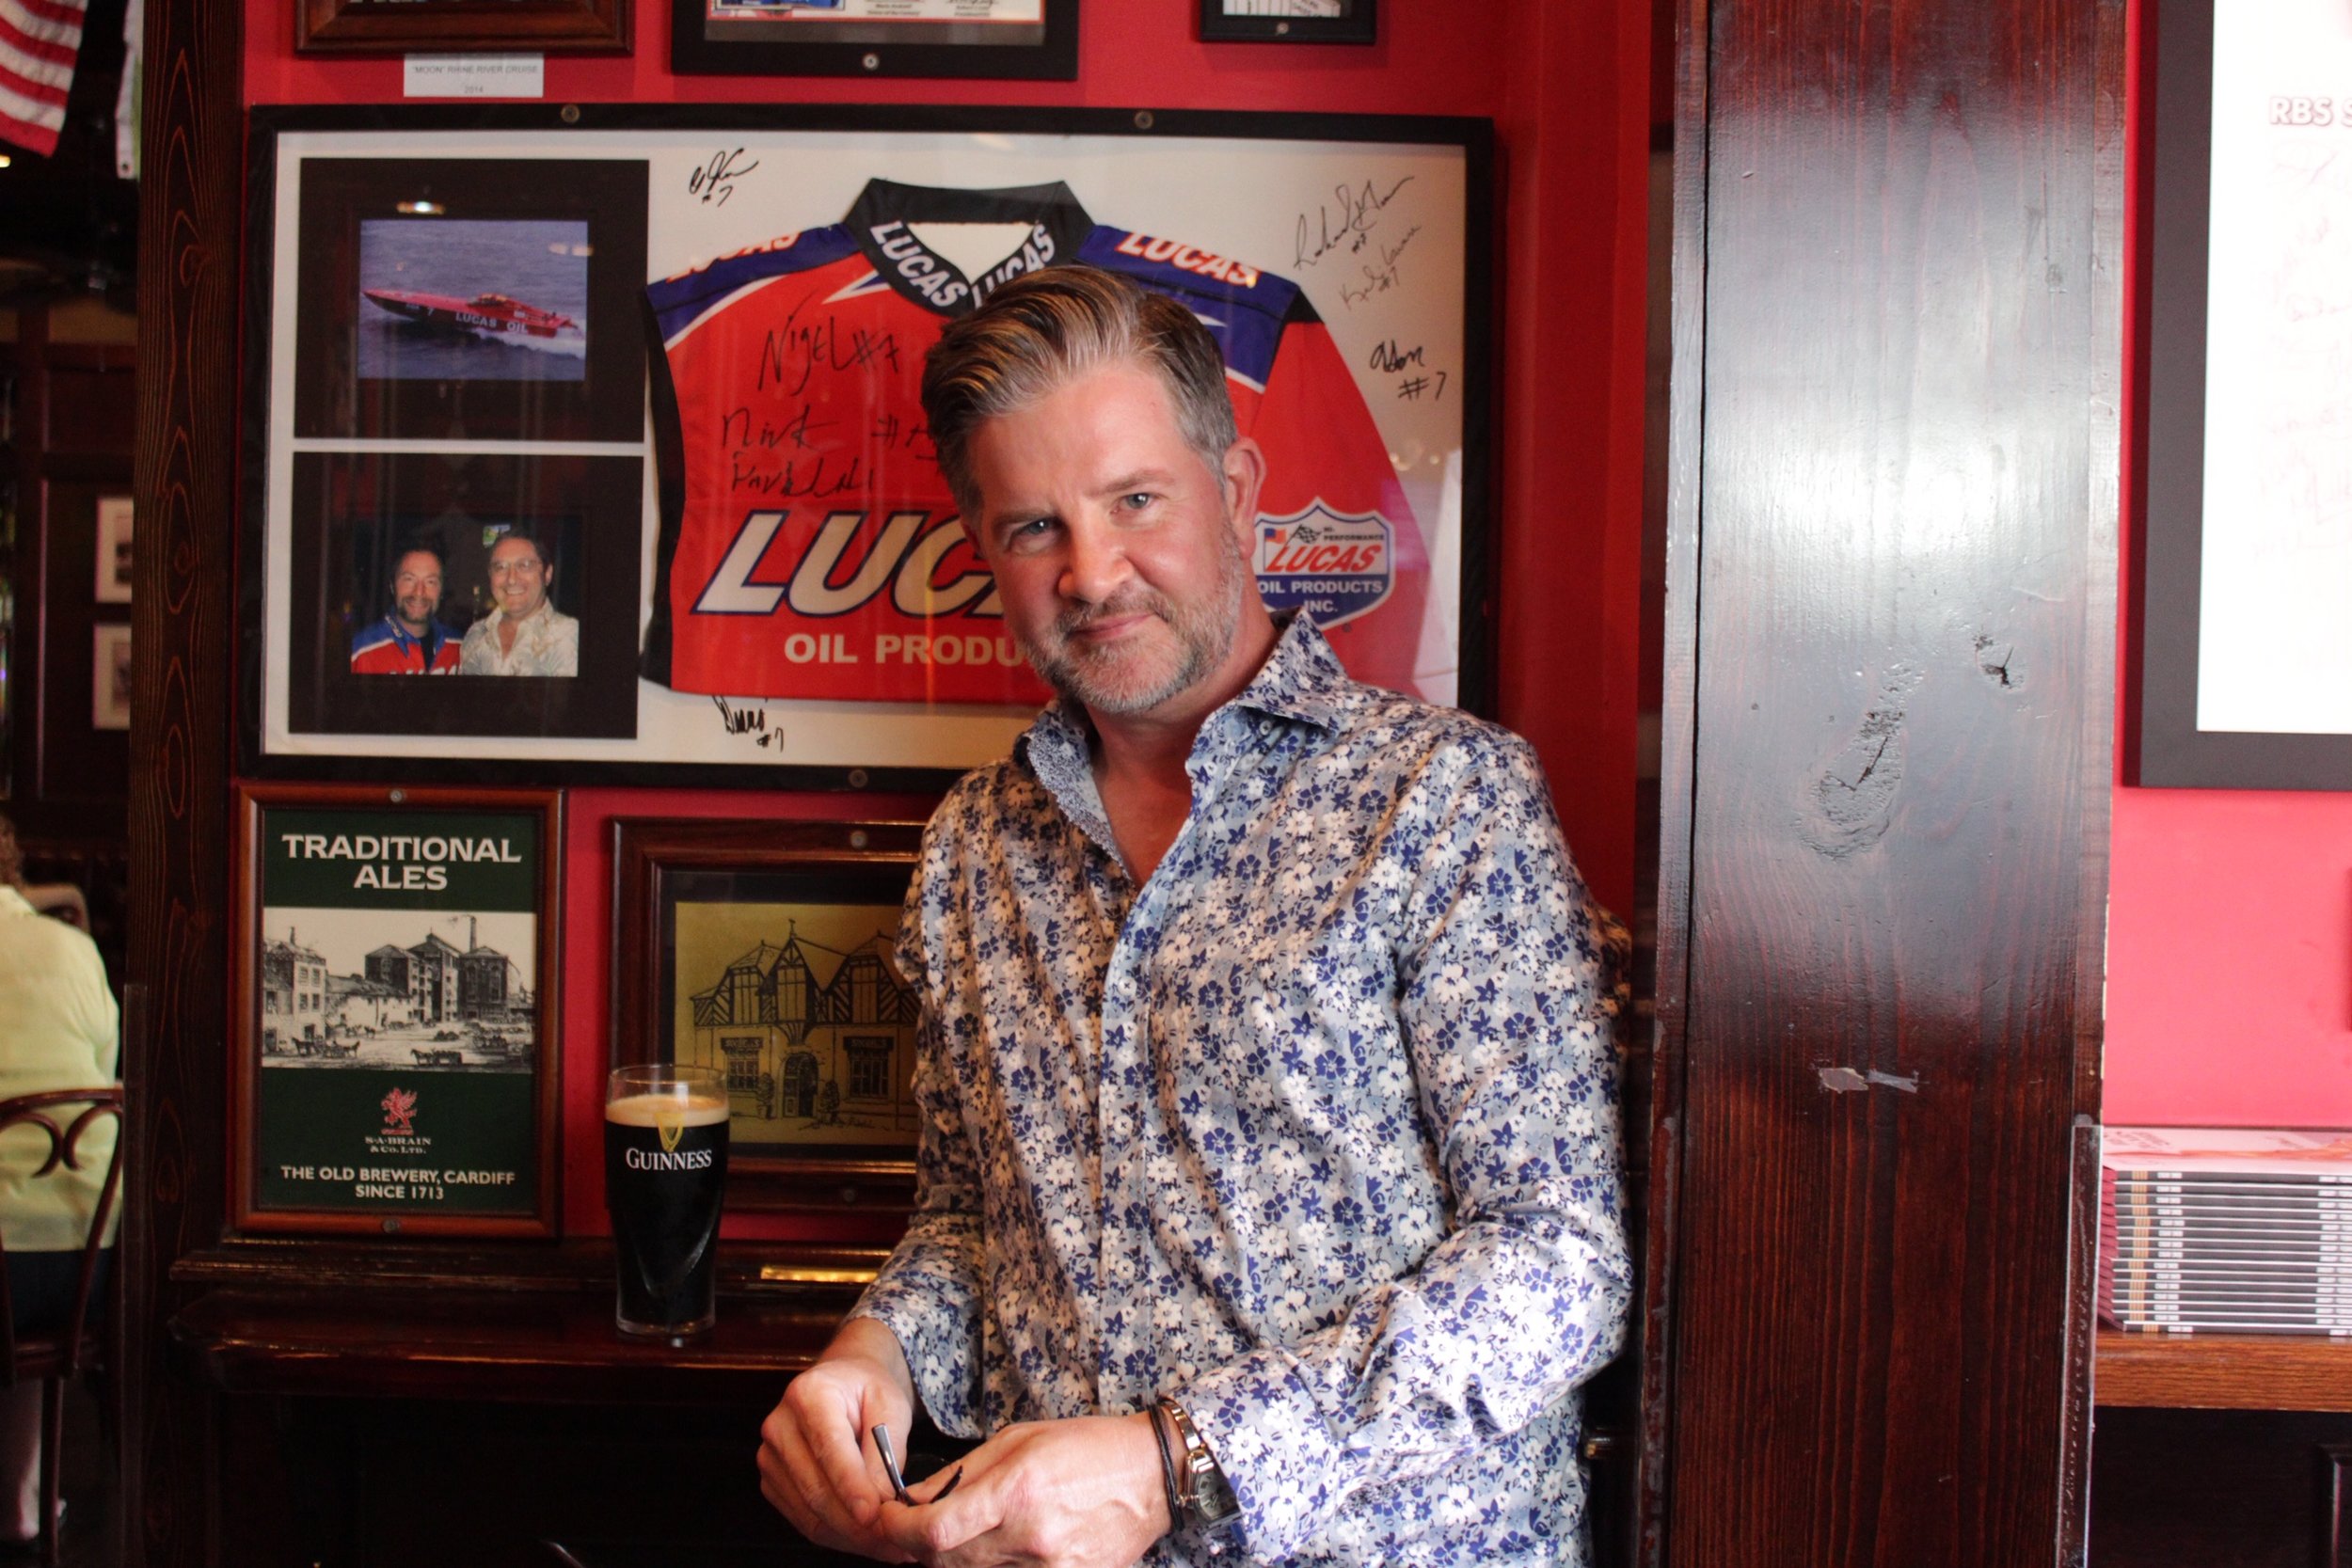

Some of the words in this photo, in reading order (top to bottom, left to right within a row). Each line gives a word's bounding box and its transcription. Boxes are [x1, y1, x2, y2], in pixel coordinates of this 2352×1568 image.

[476, 66, 503, 74] RIVER
[505, 66, 538, 74] CRUISE
[2269, 96, 2333, 127] RBS
[869, 220, 968, 308] LUCAS
[1114, 232, 1263, 288] LUCAS
[455, 312, 497, 328] LUCAS
[507, 323, 528, 333] OIL
[690, 510, 1006, 618] LUC
[1264, 545, 1382, 573] LUCAS
[1258, 580, 1286, 594] OIL
[1291, 580, 1383, 594] PRODUCTS
[1304, 600, 1339, 612] INC.
[784, 633, 858, 663] OIL
[281, 833, 522, 863] TRADITIONAL
[353, 864, 448, 891] ALES
[626, 1148, 712, 1171] GUINNESS
[281, 1165, 314, 1180] THE
[319, 1166, 355, 1181] OLD
[359, 1168, 441, 1185] BREWERY,
[444, 1171, 516, 1185] CARDIFF
[355, 1184, 405, 1199] SINCE
[411, 1185, 444, 1199] 1713
